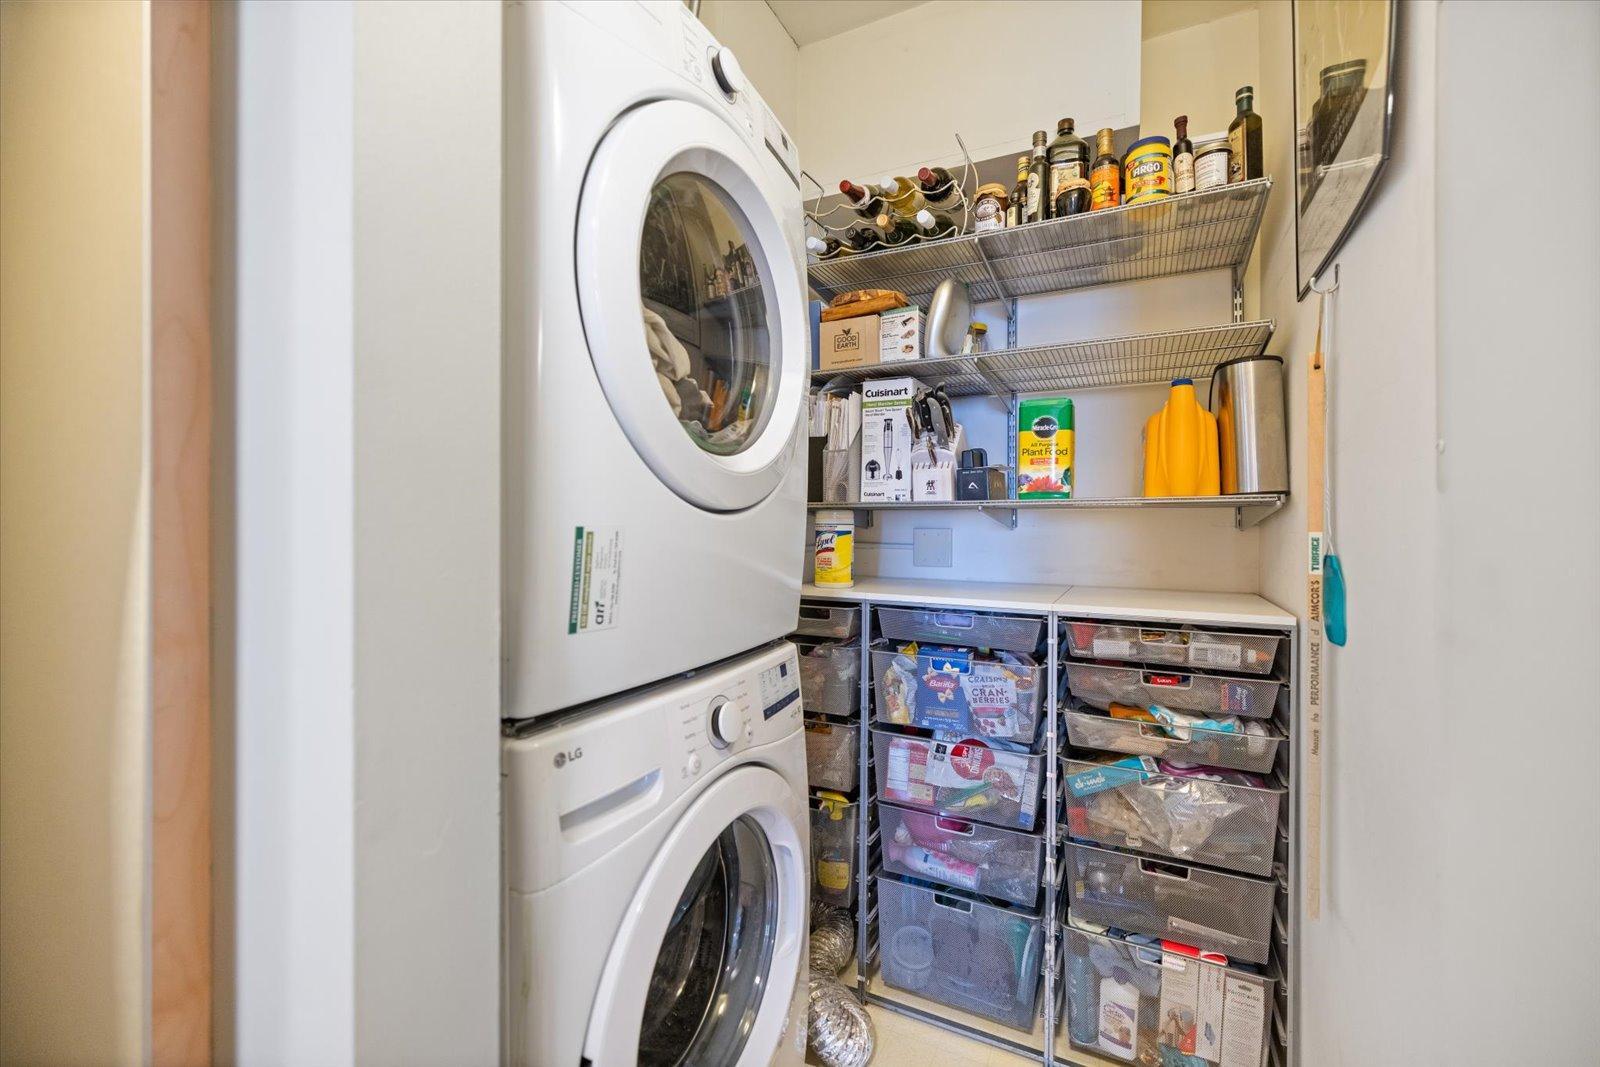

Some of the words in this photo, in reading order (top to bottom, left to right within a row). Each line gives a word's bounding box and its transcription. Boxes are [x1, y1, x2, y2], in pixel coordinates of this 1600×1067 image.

[1133, 163, 1160, 177] ARGO
[836, 341, 857, 350] EARTH
[837, 335, 857, 343] GOOD
[866, 387, 908, 397] Cuisinart
[1022, 448, 1043, 456] Plant
[816, 535, 835, 549] Lysol
[574, 538, 583, 581] CUSTOMER
[1311, 537, 1320, 572] TURFACE
[1311, 580, 1320, 622] AIMCOR'S
[1310, 642, 1320, 706] PERFORMANCE
[929, 679, 956, 689] Barilla
[972, 696, 1010, 704] BERRIES
[568, 747, 583, 762] LG
